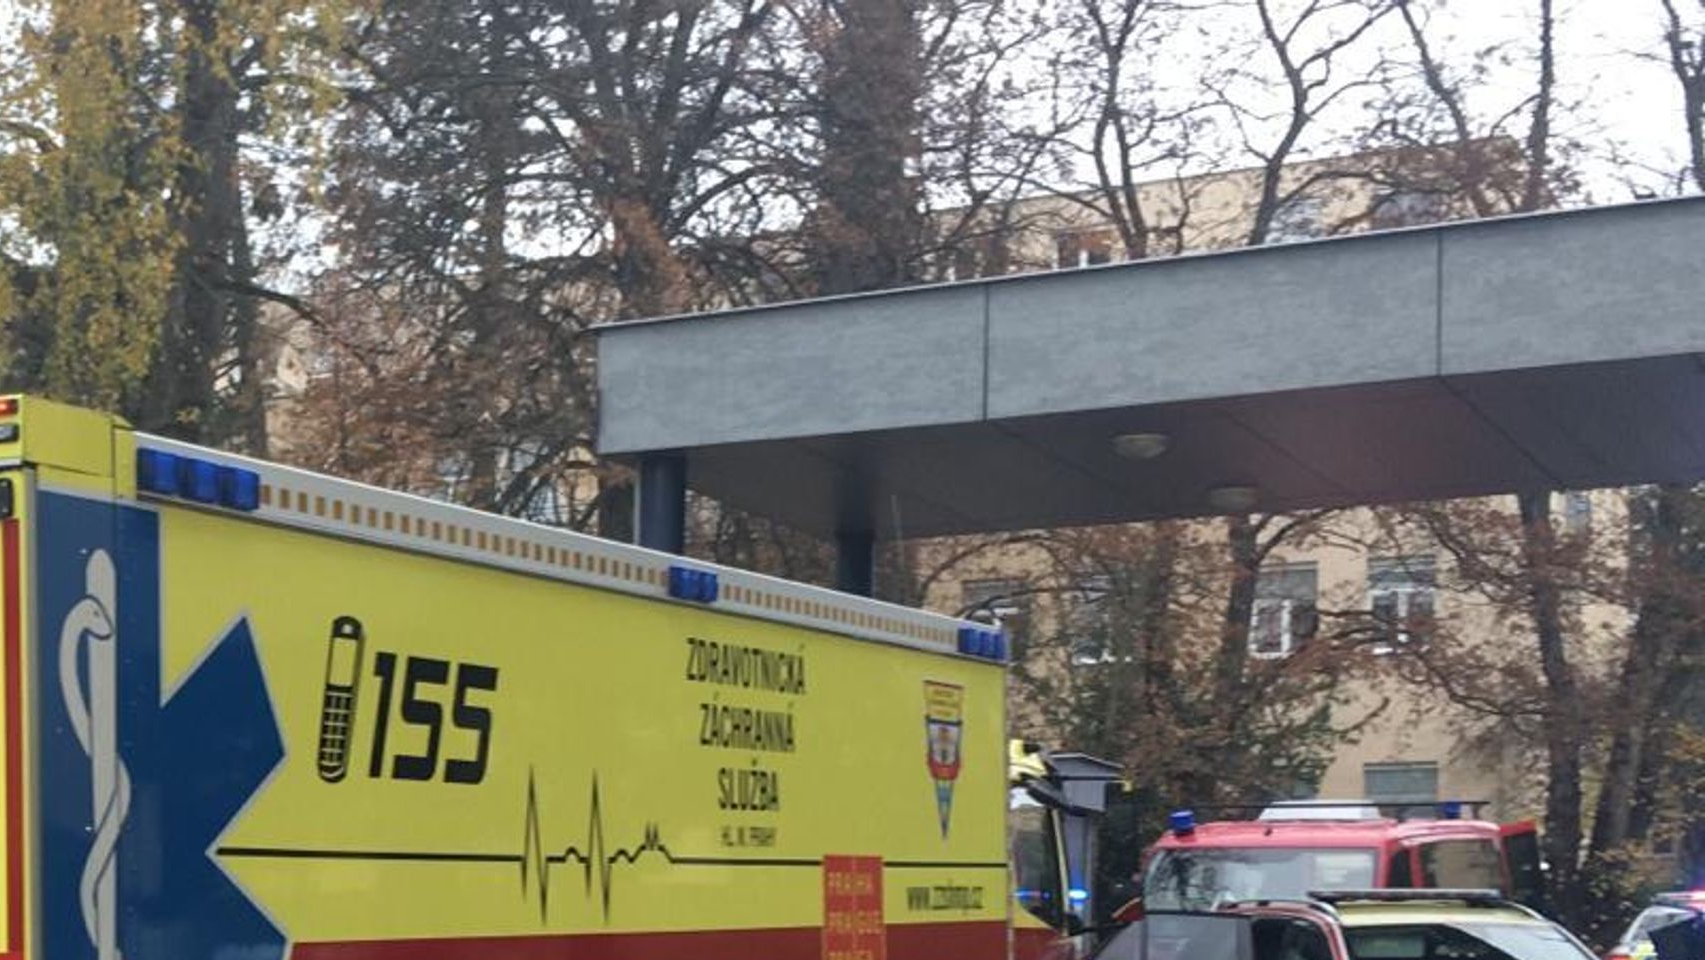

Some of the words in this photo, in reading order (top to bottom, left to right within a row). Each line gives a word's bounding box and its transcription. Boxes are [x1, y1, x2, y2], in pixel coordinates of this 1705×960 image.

[686, 636, 806, 695] ZDRAVOTNICKÁ
[368, 651, 500, 785] 155
[699, 691, 796, 753] ZÁCHRANNÁ
[717, 758, 780, 812] SLUŽBA
